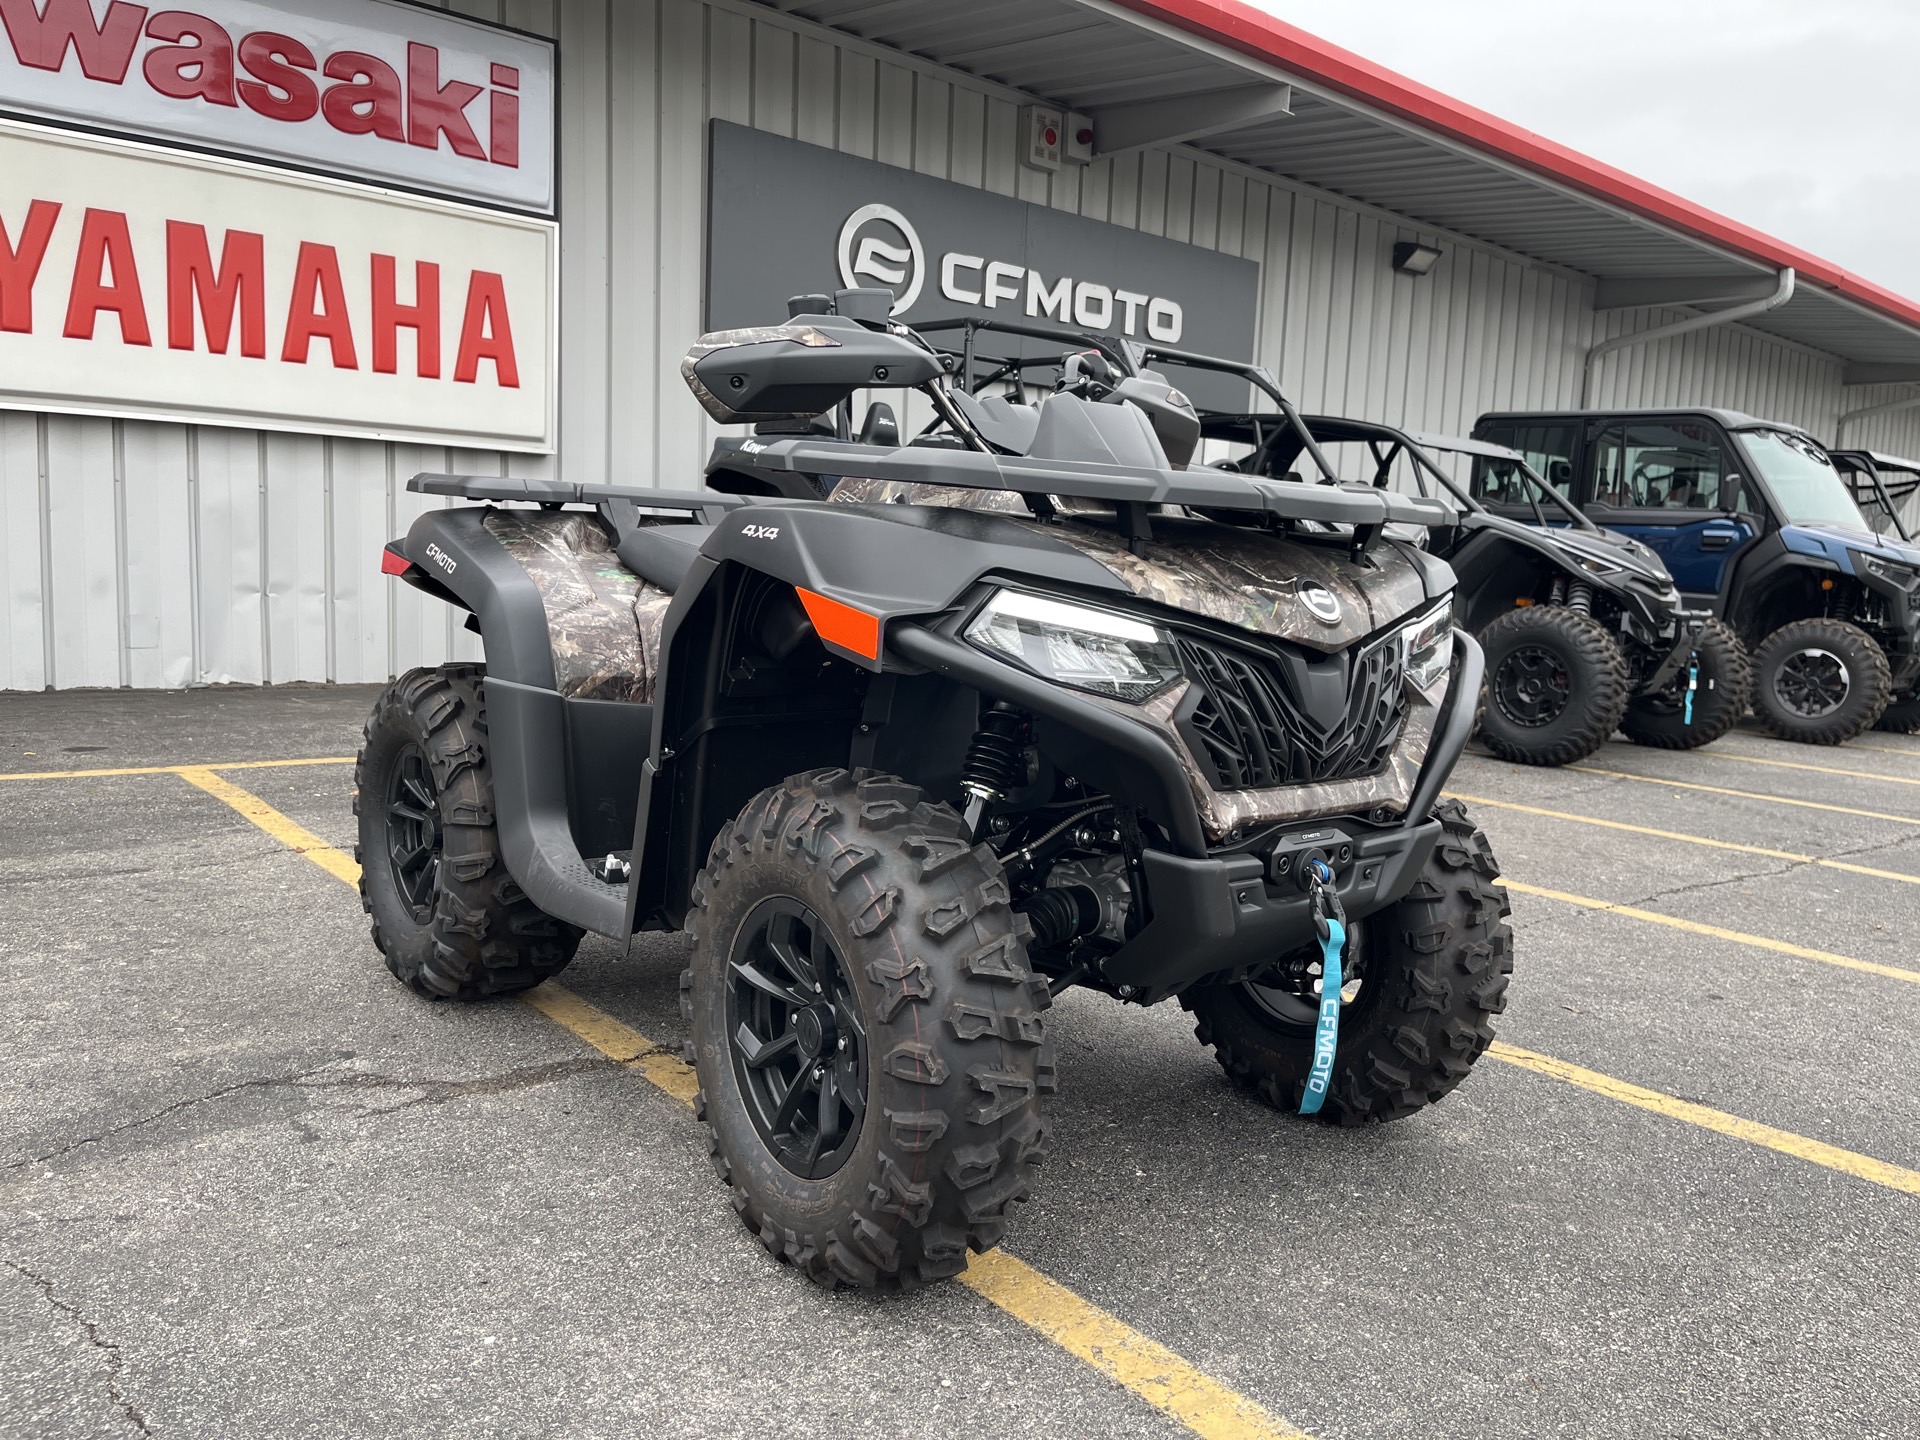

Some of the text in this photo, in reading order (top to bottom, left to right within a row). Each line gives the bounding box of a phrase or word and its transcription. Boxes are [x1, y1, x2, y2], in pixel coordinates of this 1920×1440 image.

[0, 0, 520, 169] wasaki
[0, 198, 521, 389] YAMAHA
[941, 251, 1184, 344] CFMOTO
[425, 542, 457, 575] CFMOTO
[1309, 998, 1338, 1094] CFMOTO
